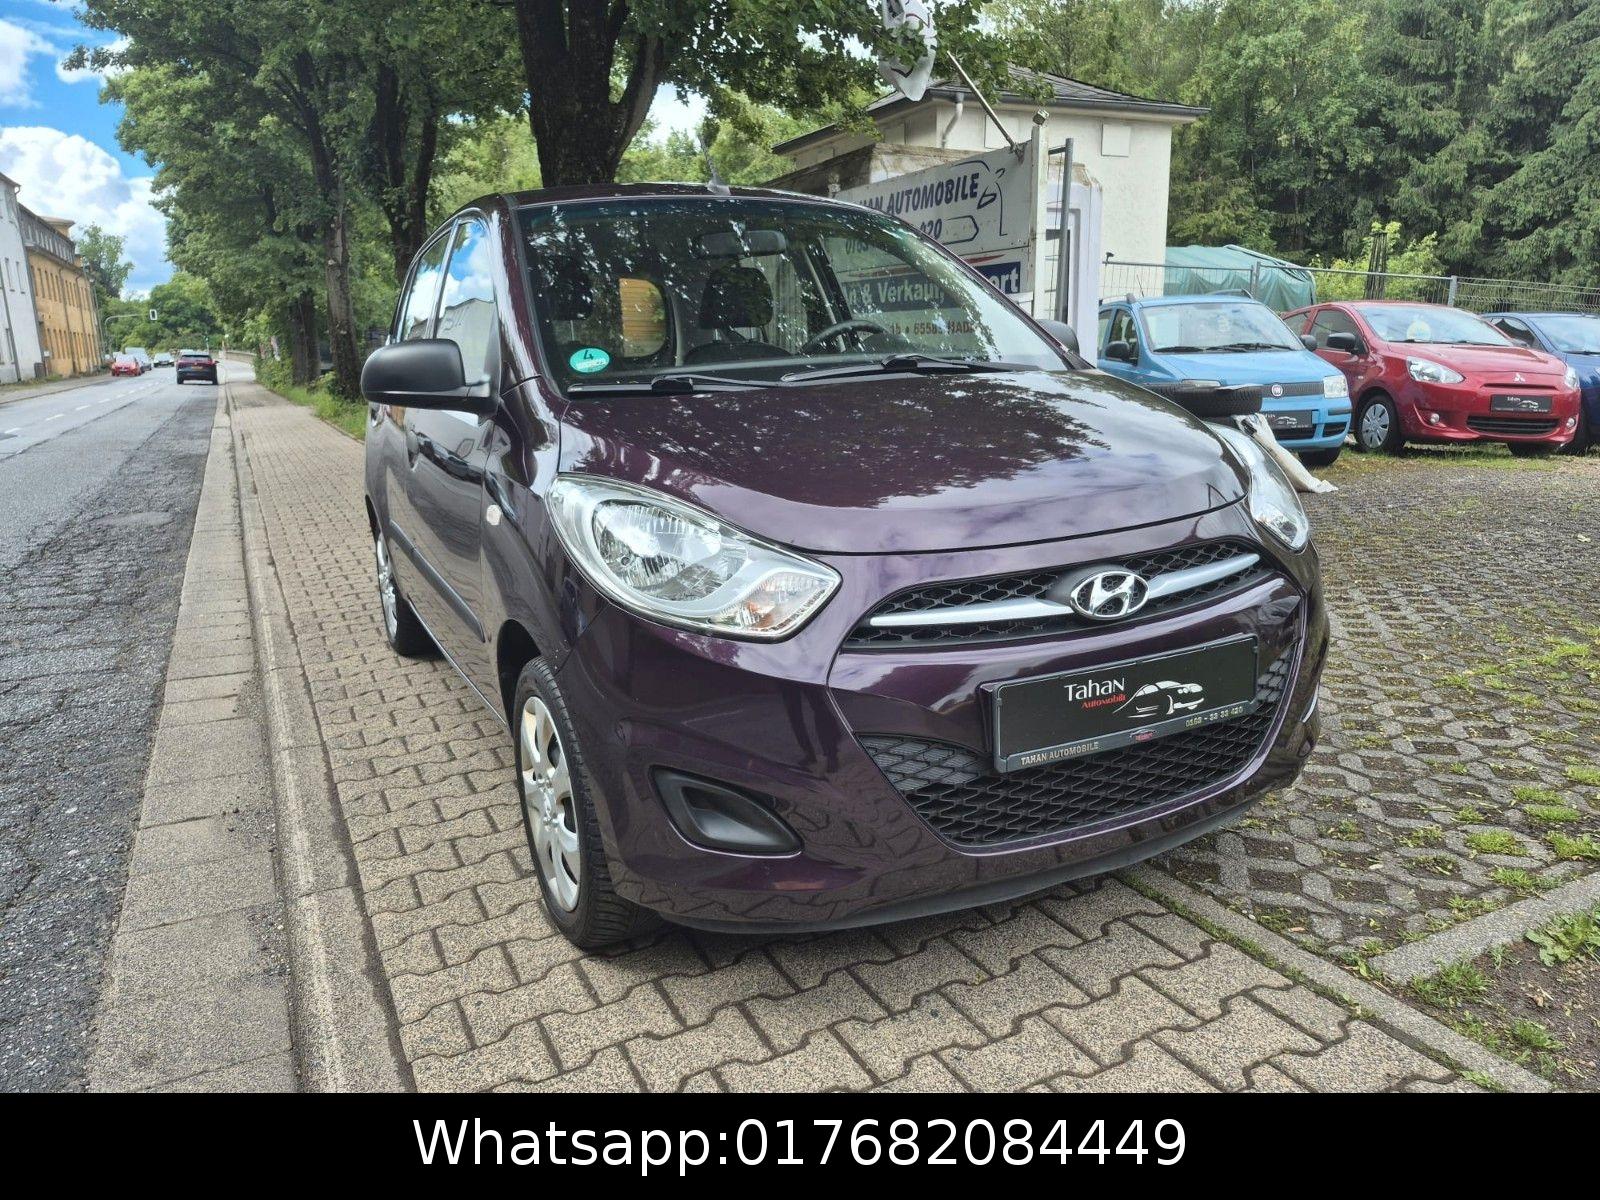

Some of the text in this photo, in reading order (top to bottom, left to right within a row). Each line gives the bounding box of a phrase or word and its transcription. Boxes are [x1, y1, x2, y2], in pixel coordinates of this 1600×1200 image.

[886, 173, 980, 215] AUTOMOBILE
[988, 267, 1019, 294] ort
[1020, 741, 1099, 766] TAHAN AUTOMOBILE
